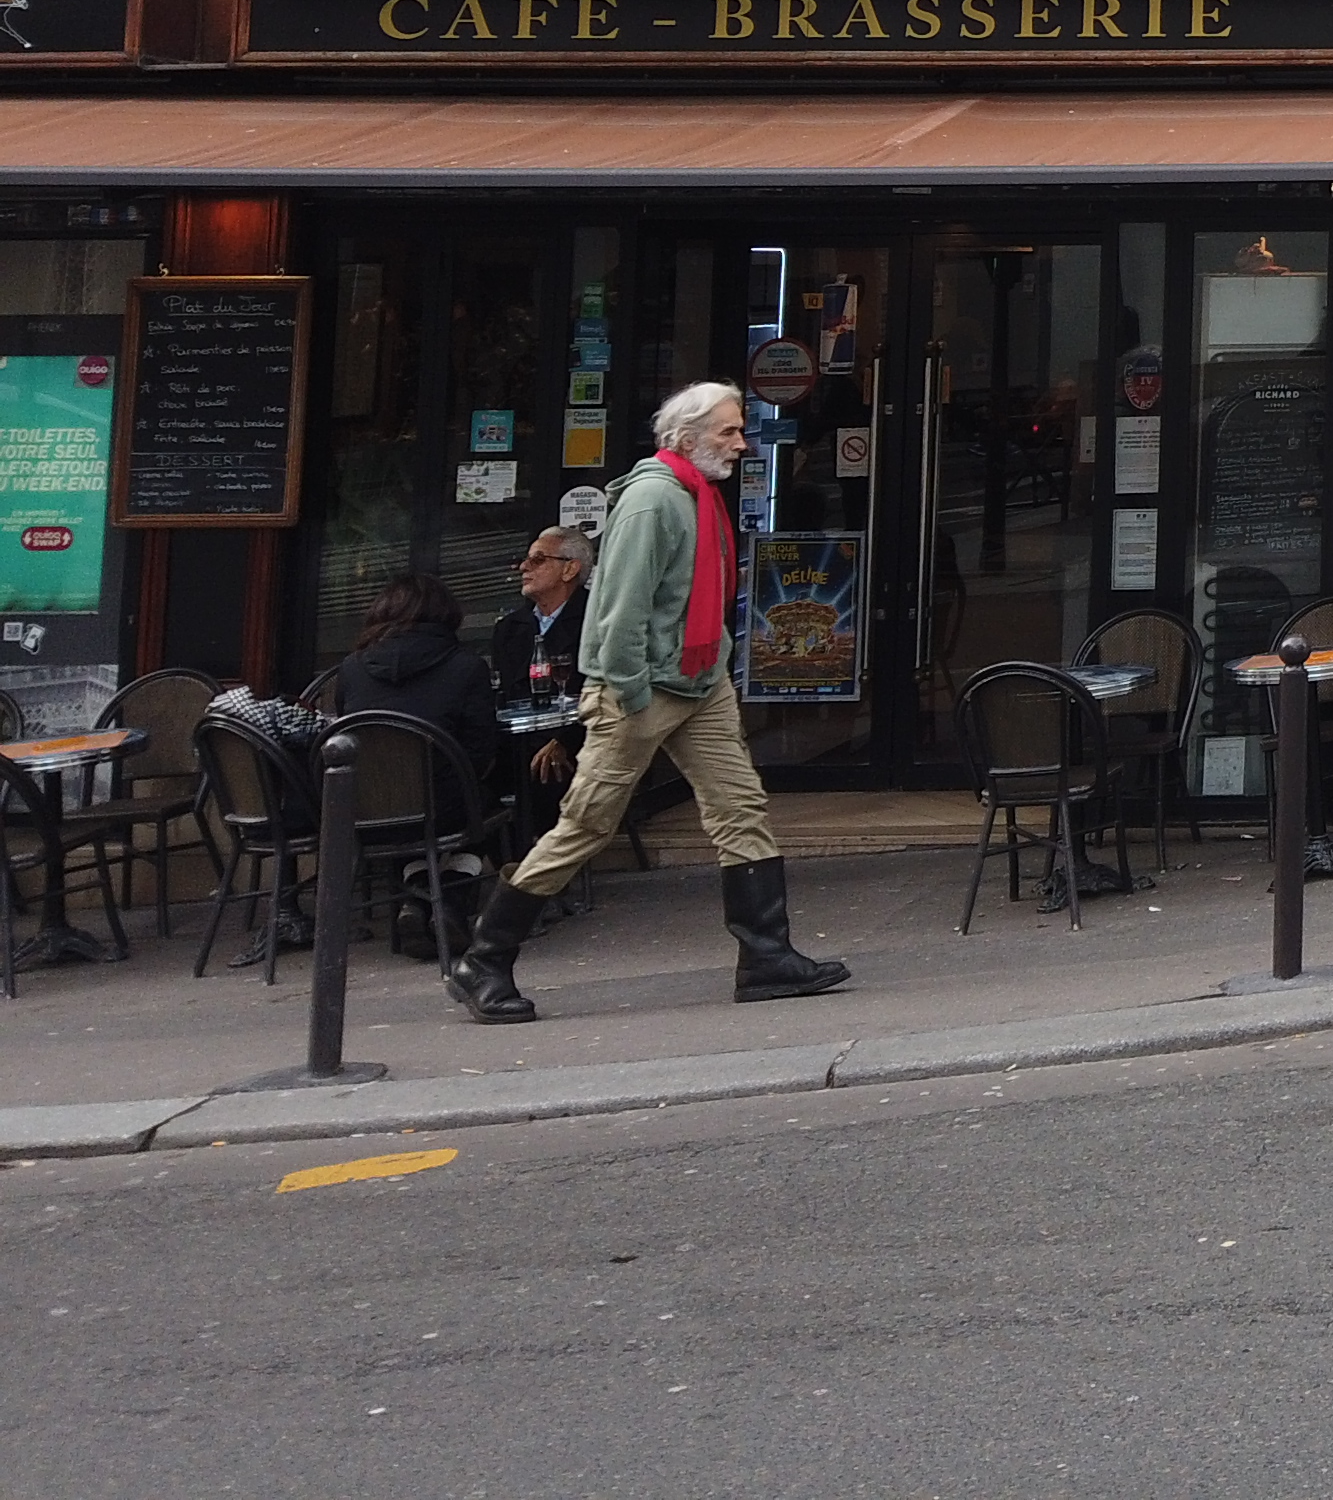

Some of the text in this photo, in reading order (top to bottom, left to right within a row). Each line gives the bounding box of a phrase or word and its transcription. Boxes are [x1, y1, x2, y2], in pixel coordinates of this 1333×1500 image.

[163, 295, 204, 313] Plat
[212, 296, 236, 312] du
[167, 344, 232, 356] Parmentier
[237, 344, 251, 355] de
[1255, 390, 1300, 399] RICHARD
[54, 444, 98, 458] SEUL
[156, 455, 245, 467] DESSERT
[13, 476, 108, 491] WEEK-END.
[570, 491, 598, 499] MAGASIN
[760, 544, 797, 553] CIRQUE
[760, 553, 799, 561] D'HIVER
